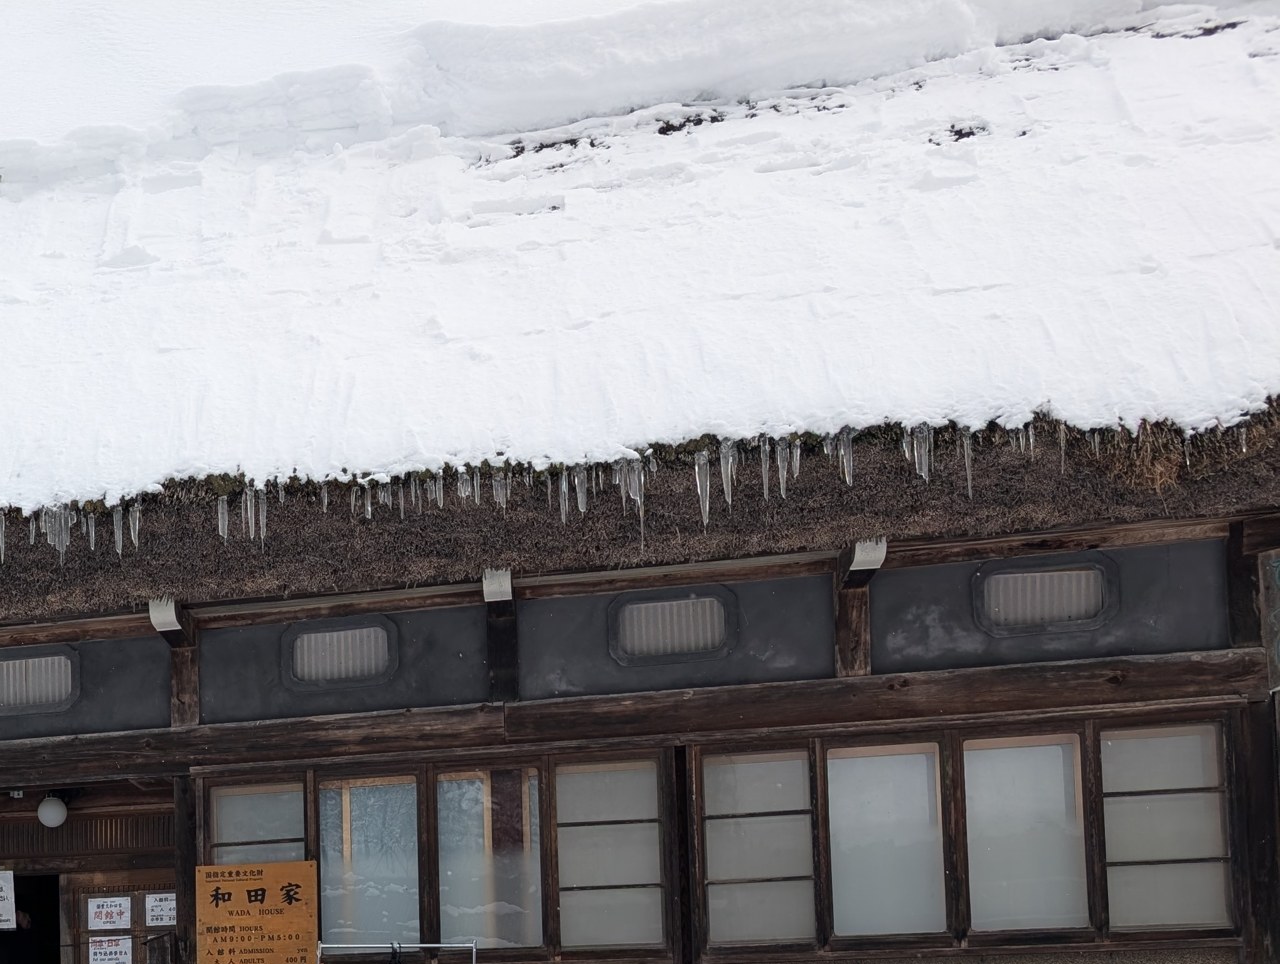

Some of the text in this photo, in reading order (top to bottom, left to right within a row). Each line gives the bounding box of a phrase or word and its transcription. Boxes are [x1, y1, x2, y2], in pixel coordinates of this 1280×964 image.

[205, 868, 264, 879] 国指定重要文化財
[210, 882, 302, 908] 和田家
[206, 926, 236, 934] 開館時間
